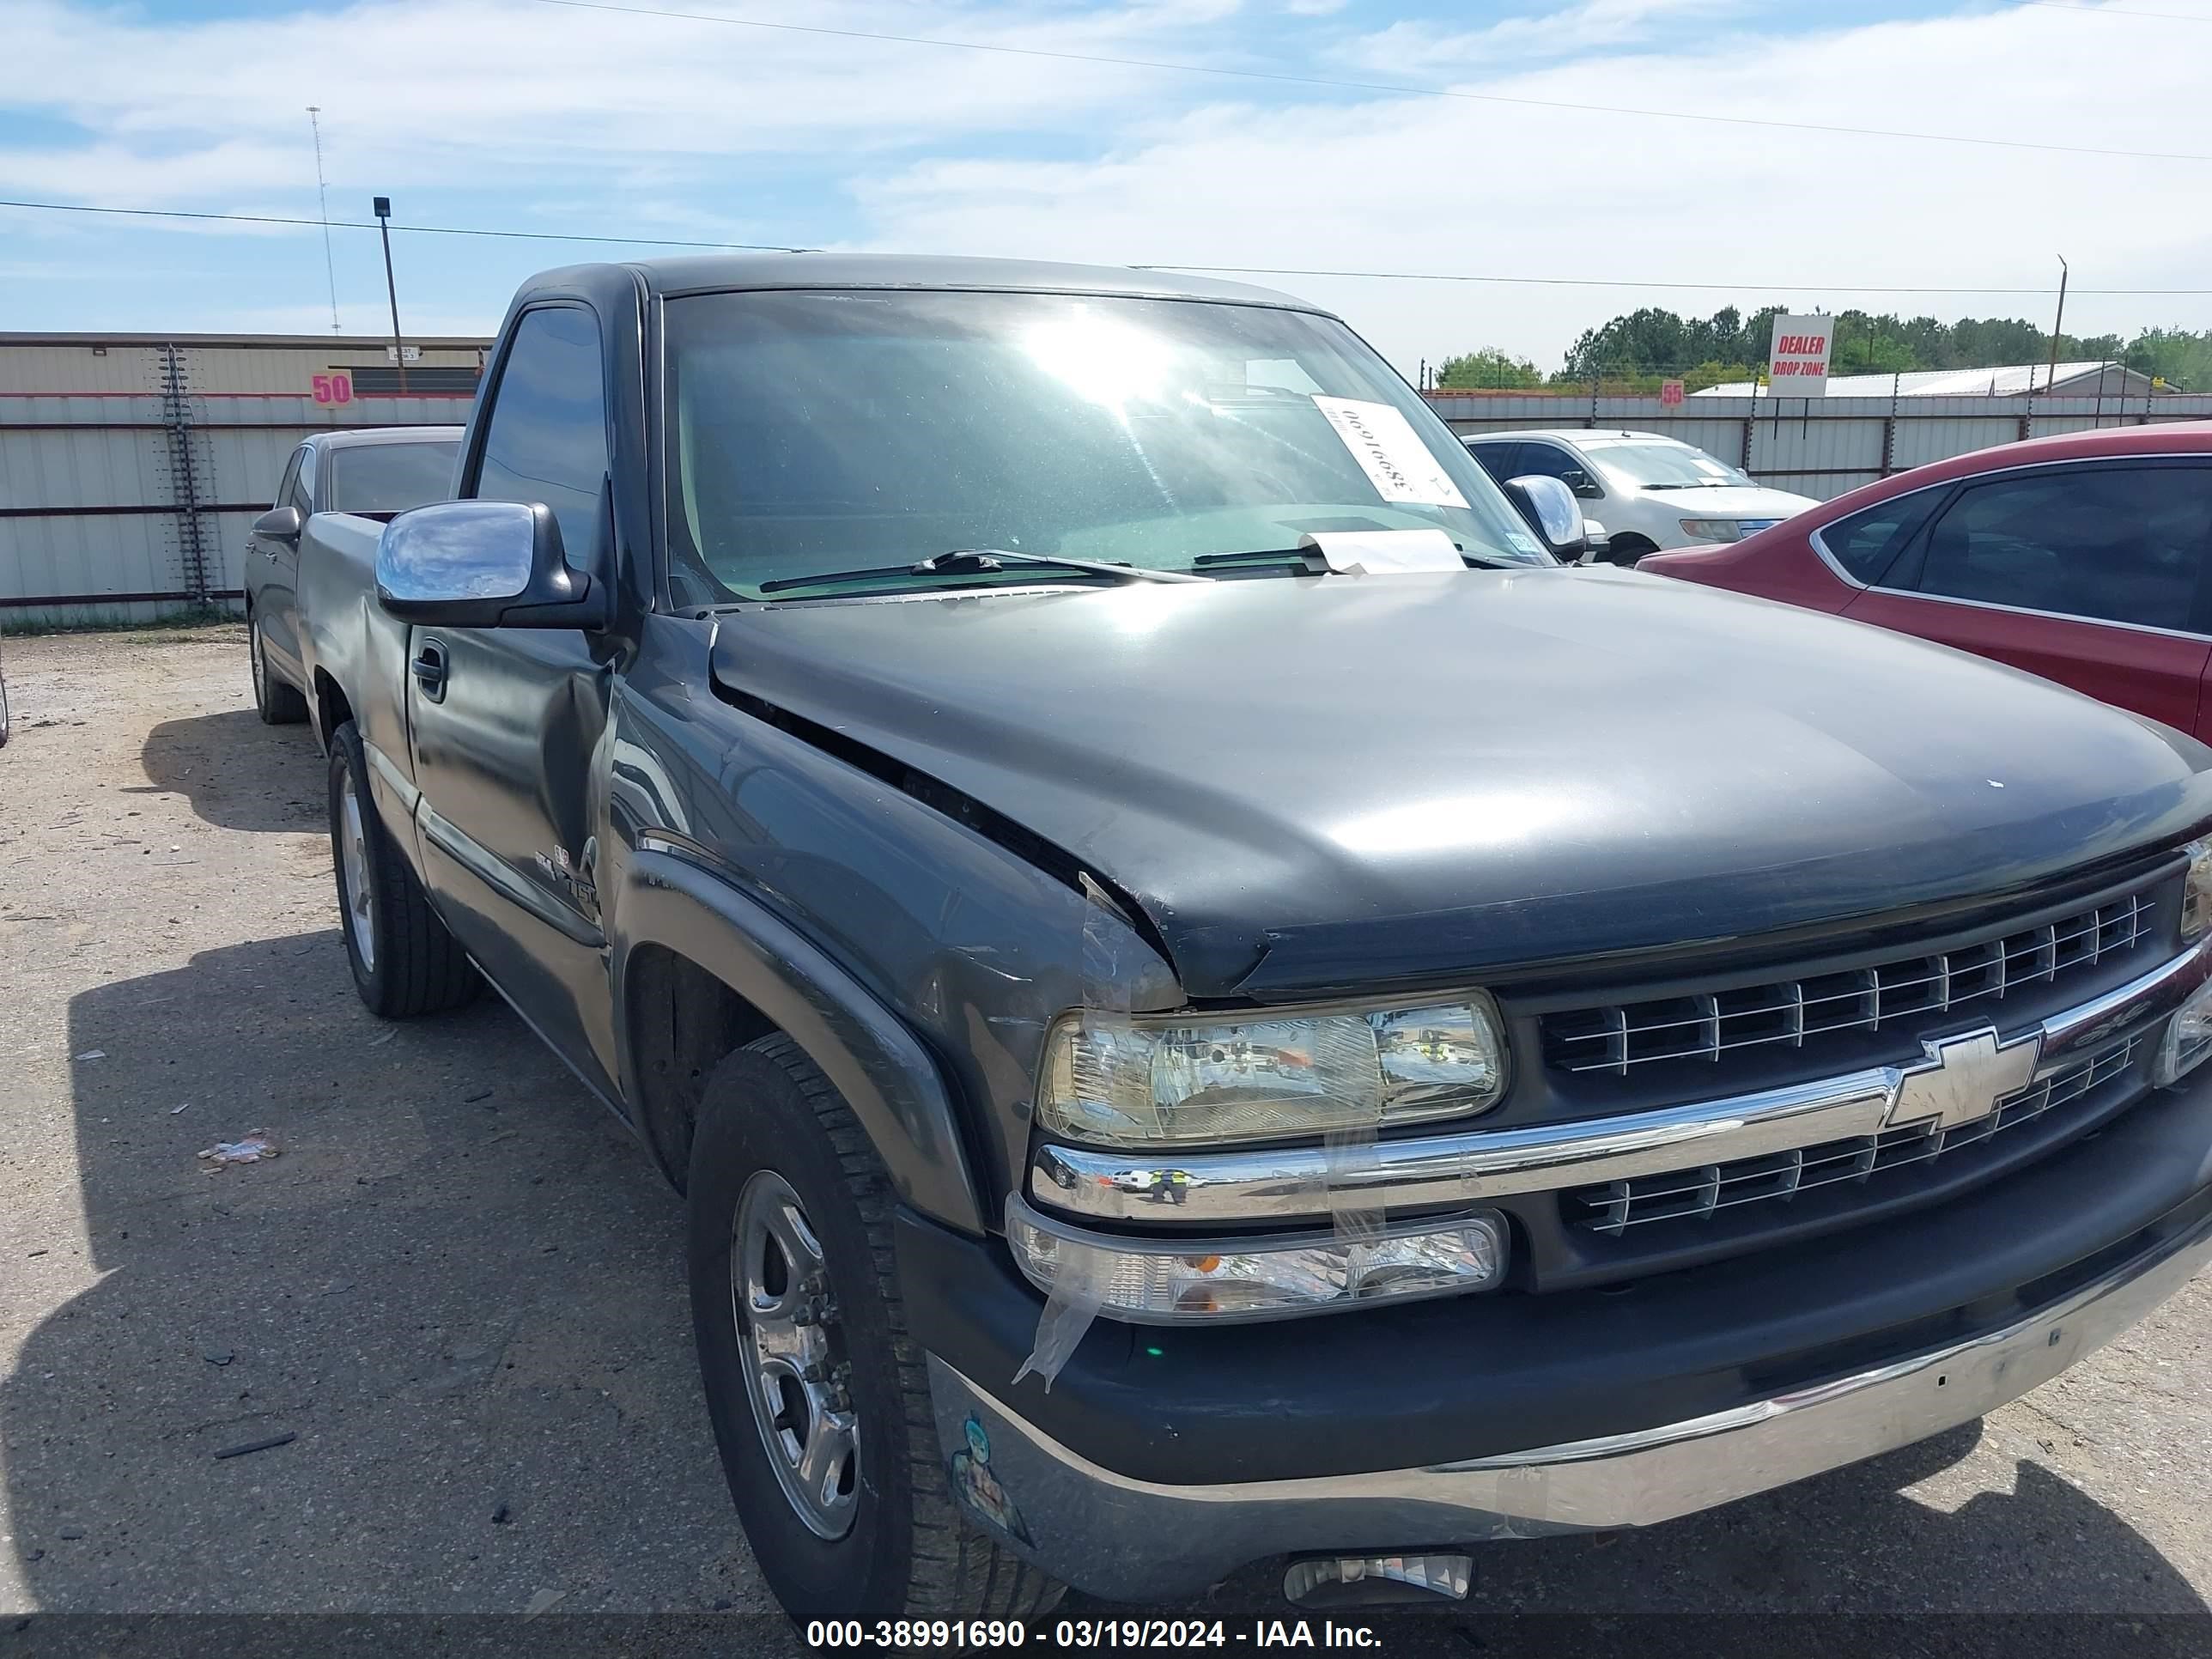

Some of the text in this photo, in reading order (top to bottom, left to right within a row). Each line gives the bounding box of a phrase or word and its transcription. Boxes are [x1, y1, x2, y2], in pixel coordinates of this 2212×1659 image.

[1778, 336, 1826, 355] DEALER
[1772, 361, 1826, 376] DROP ZONE
[312, 375, 351, 404] 50
[1662, 384, 1682, 404] 55
[1342, 410, 1413, 491] 38991690
